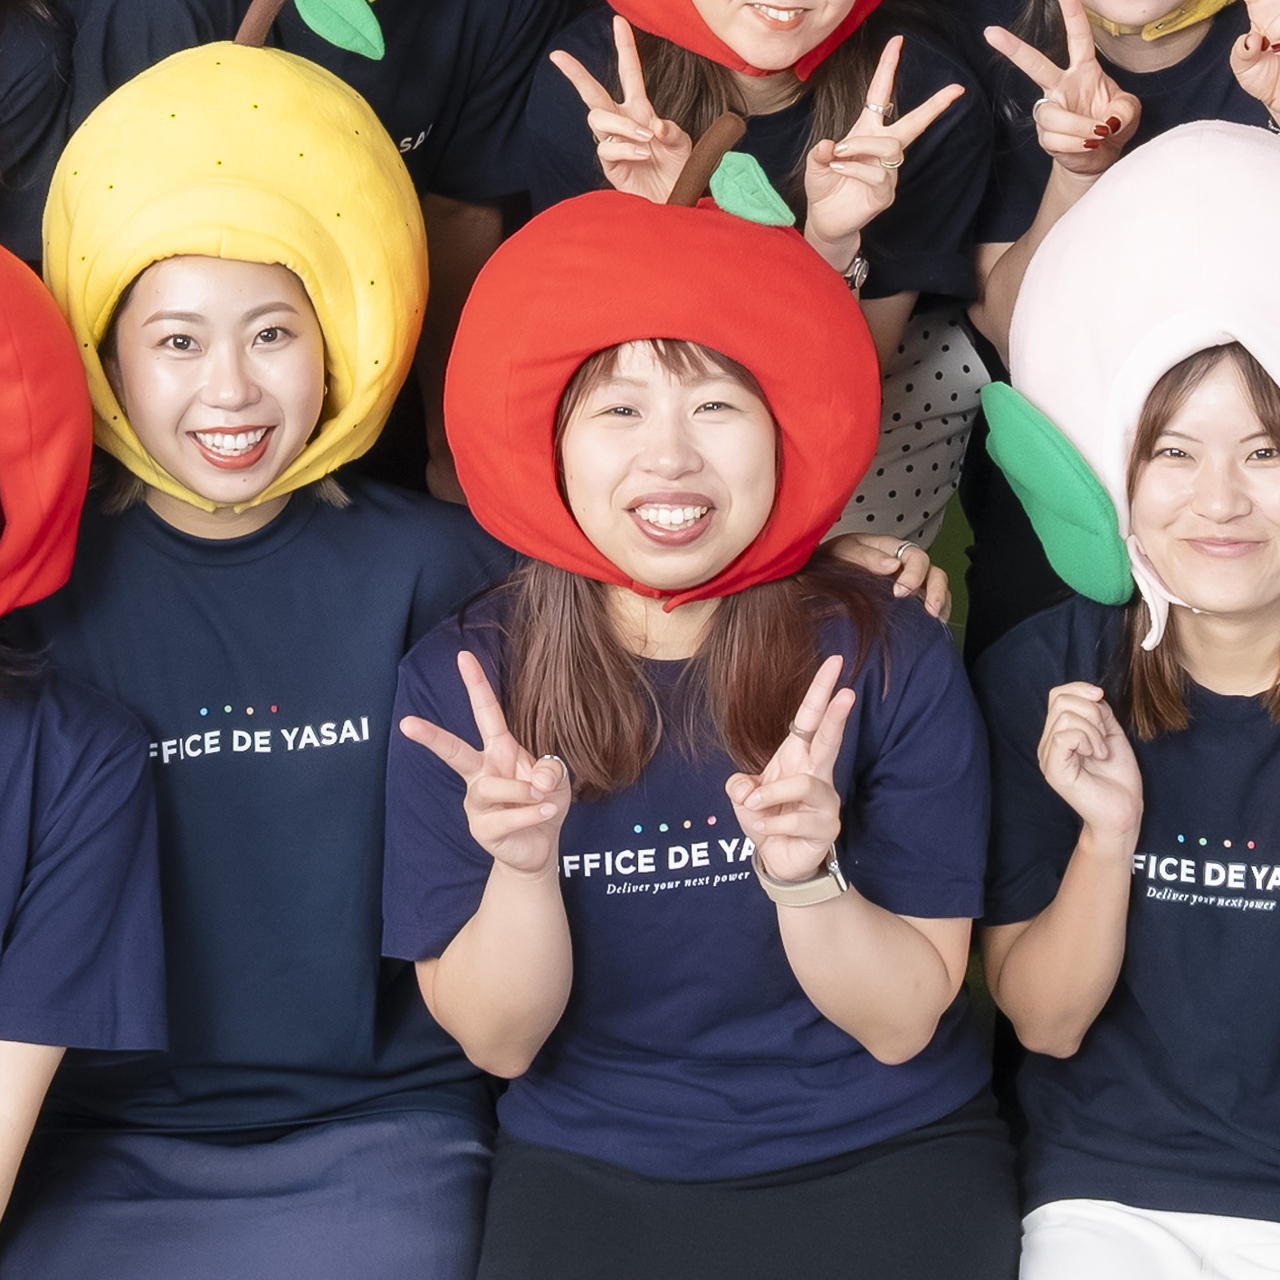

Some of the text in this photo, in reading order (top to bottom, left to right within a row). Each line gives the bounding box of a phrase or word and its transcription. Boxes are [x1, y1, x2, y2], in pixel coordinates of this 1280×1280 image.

[233, 730, 271, 752] DE
[280, 716, 369, 751] YASAI
[563, 848, 656, 878] FFICE
[668, 842, 710, 869] DE
[606, 872, 750, 895] Deliver your next power
[1204, 861, 1246, 889] DE
[1147, 886, 1189, 901] Deliver
[1217, 896, 1243, 907] next
[1242, 900, 1277, 911] power
